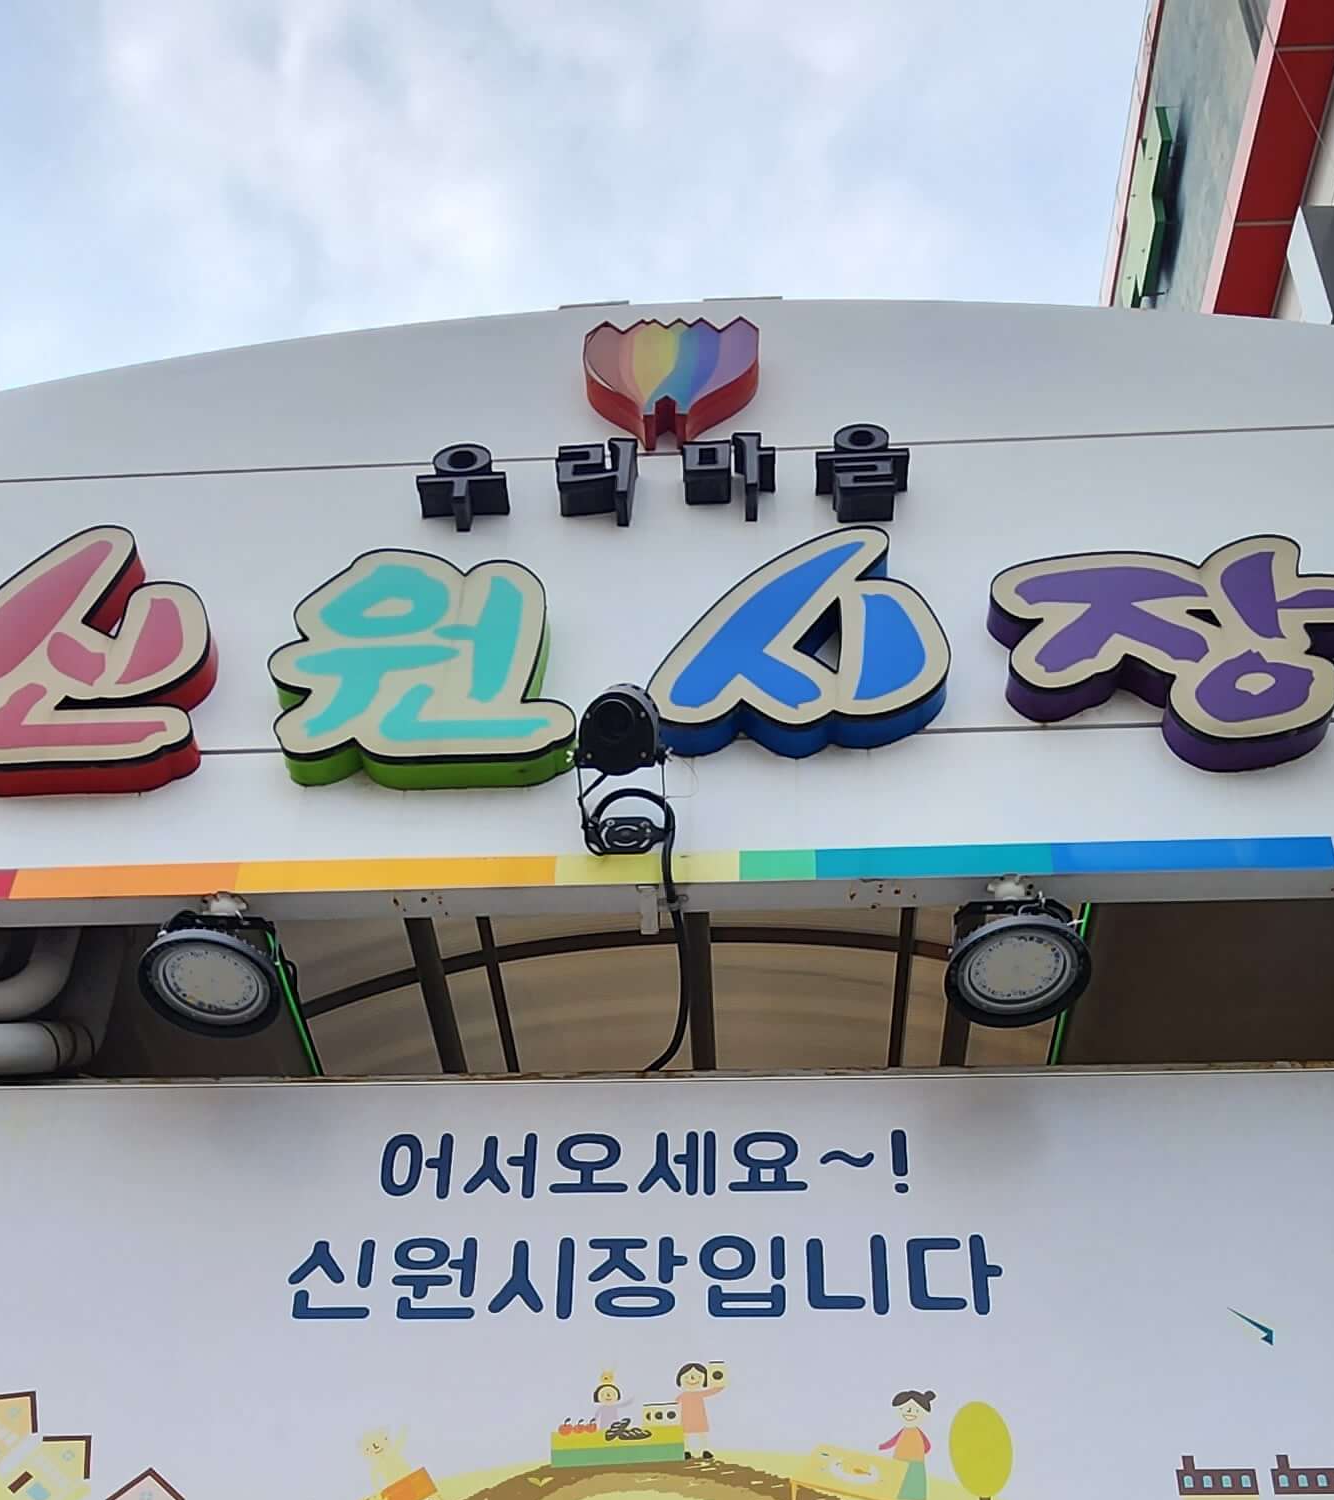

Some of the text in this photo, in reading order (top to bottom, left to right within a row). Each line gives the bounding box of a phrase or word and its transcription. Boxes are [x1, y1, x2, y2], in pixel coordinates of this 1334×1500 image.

[417, 420, 911, 533] 우리마을
[379, 1127, 912, 1201] 어서오세요~!
[286, 1233, 1005, 1321] 신원시장입니다
